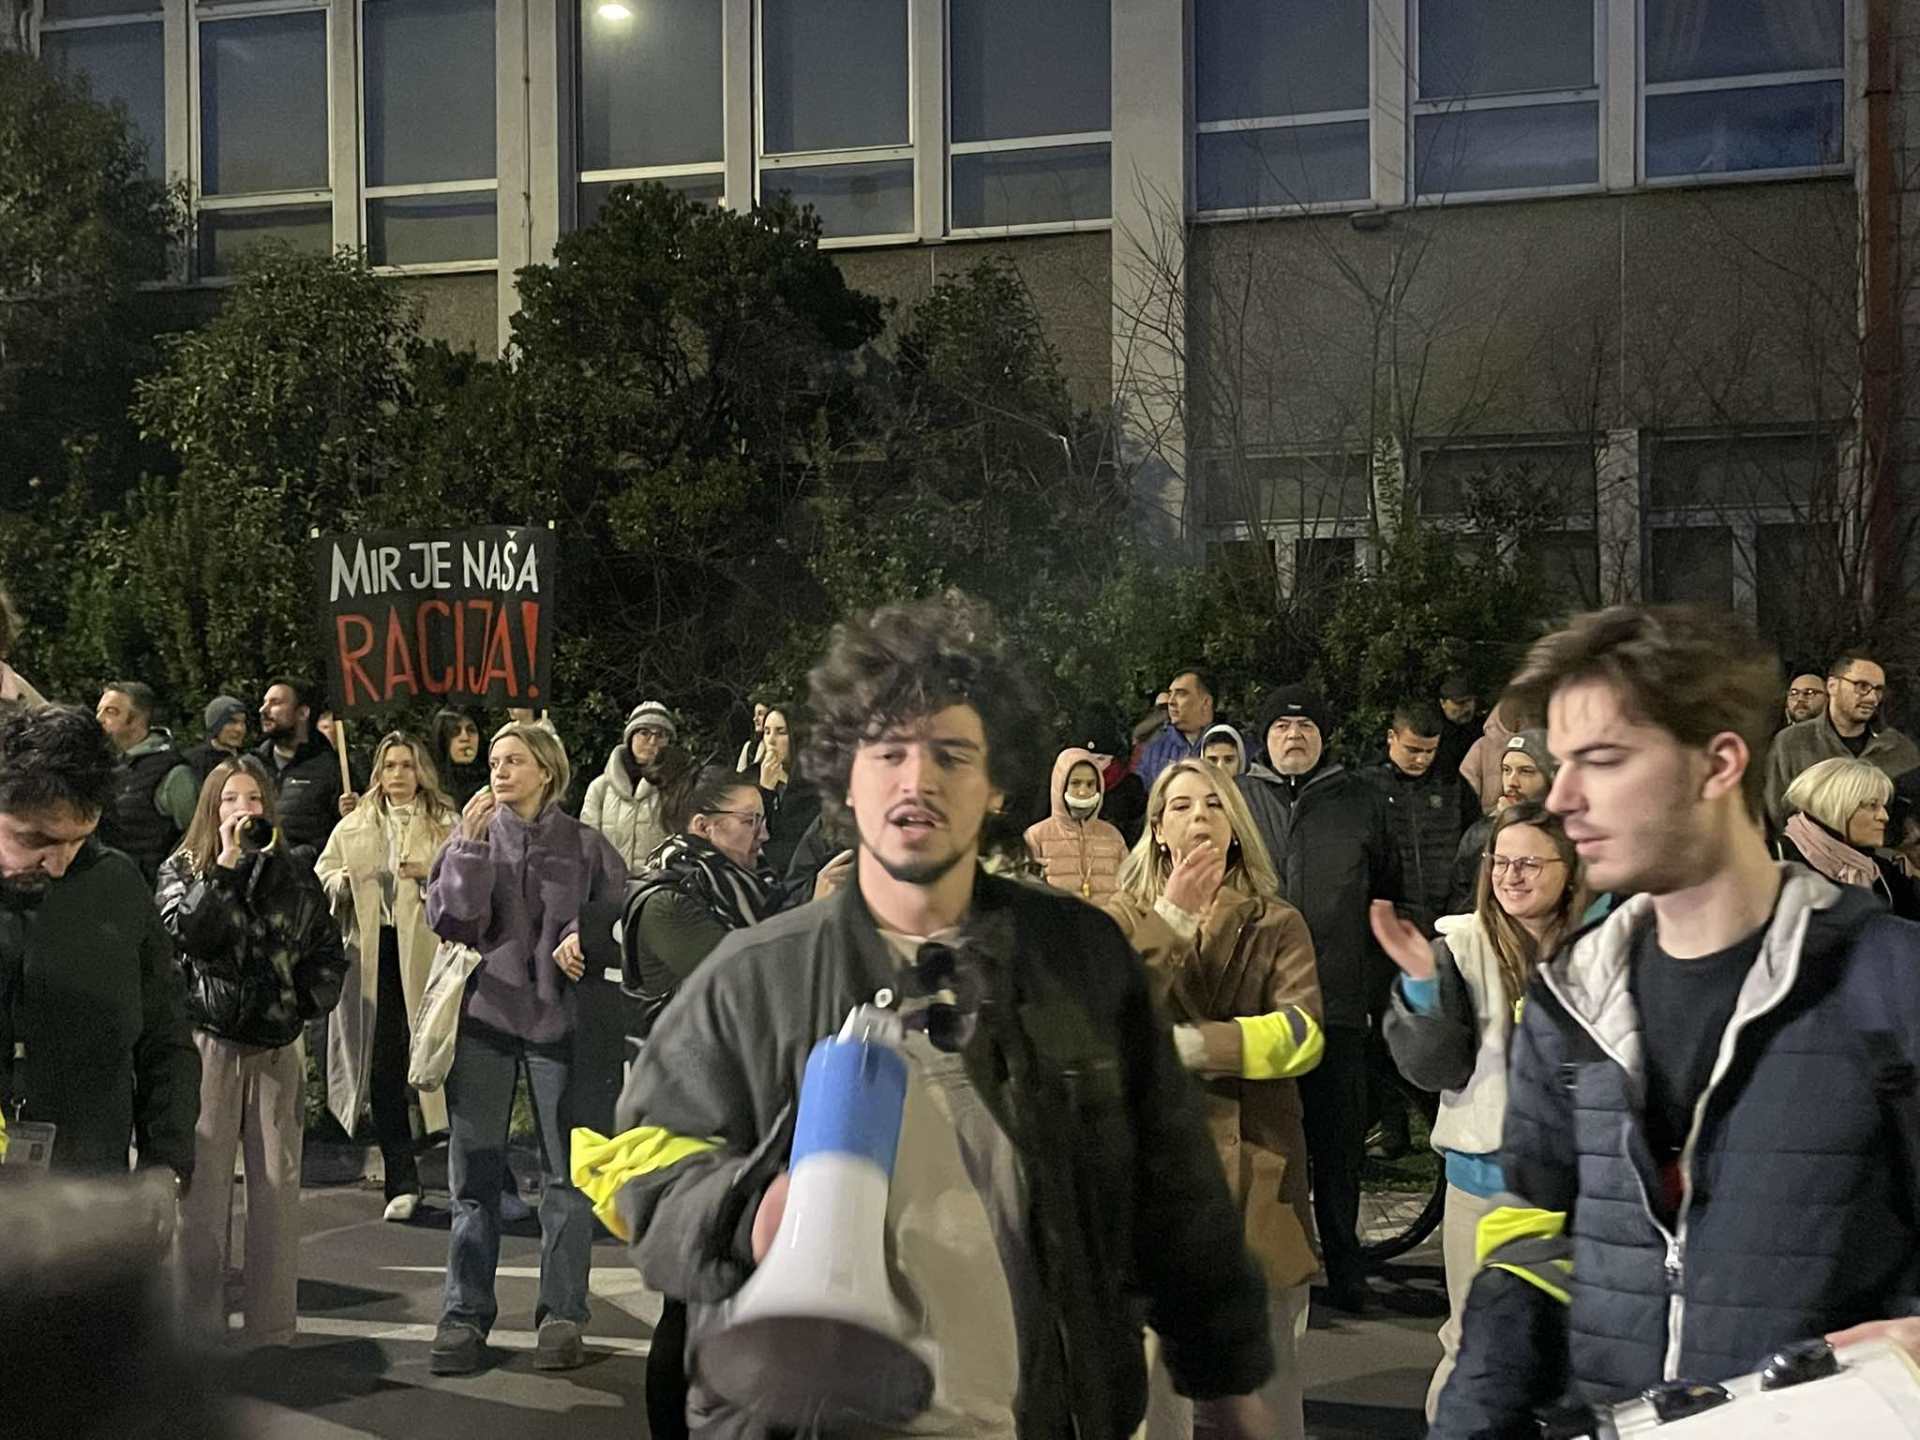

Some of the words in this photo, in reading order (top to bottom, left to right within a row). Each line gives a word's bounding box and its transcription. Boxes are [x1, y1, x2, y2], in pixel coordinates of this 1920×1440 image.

[330, 538, 402, 602] MIR
[409, 541, 451, 589] JE
[462, 530, 539, 593] NAŠA
[336, 600, 540, 705] RACIJA!
